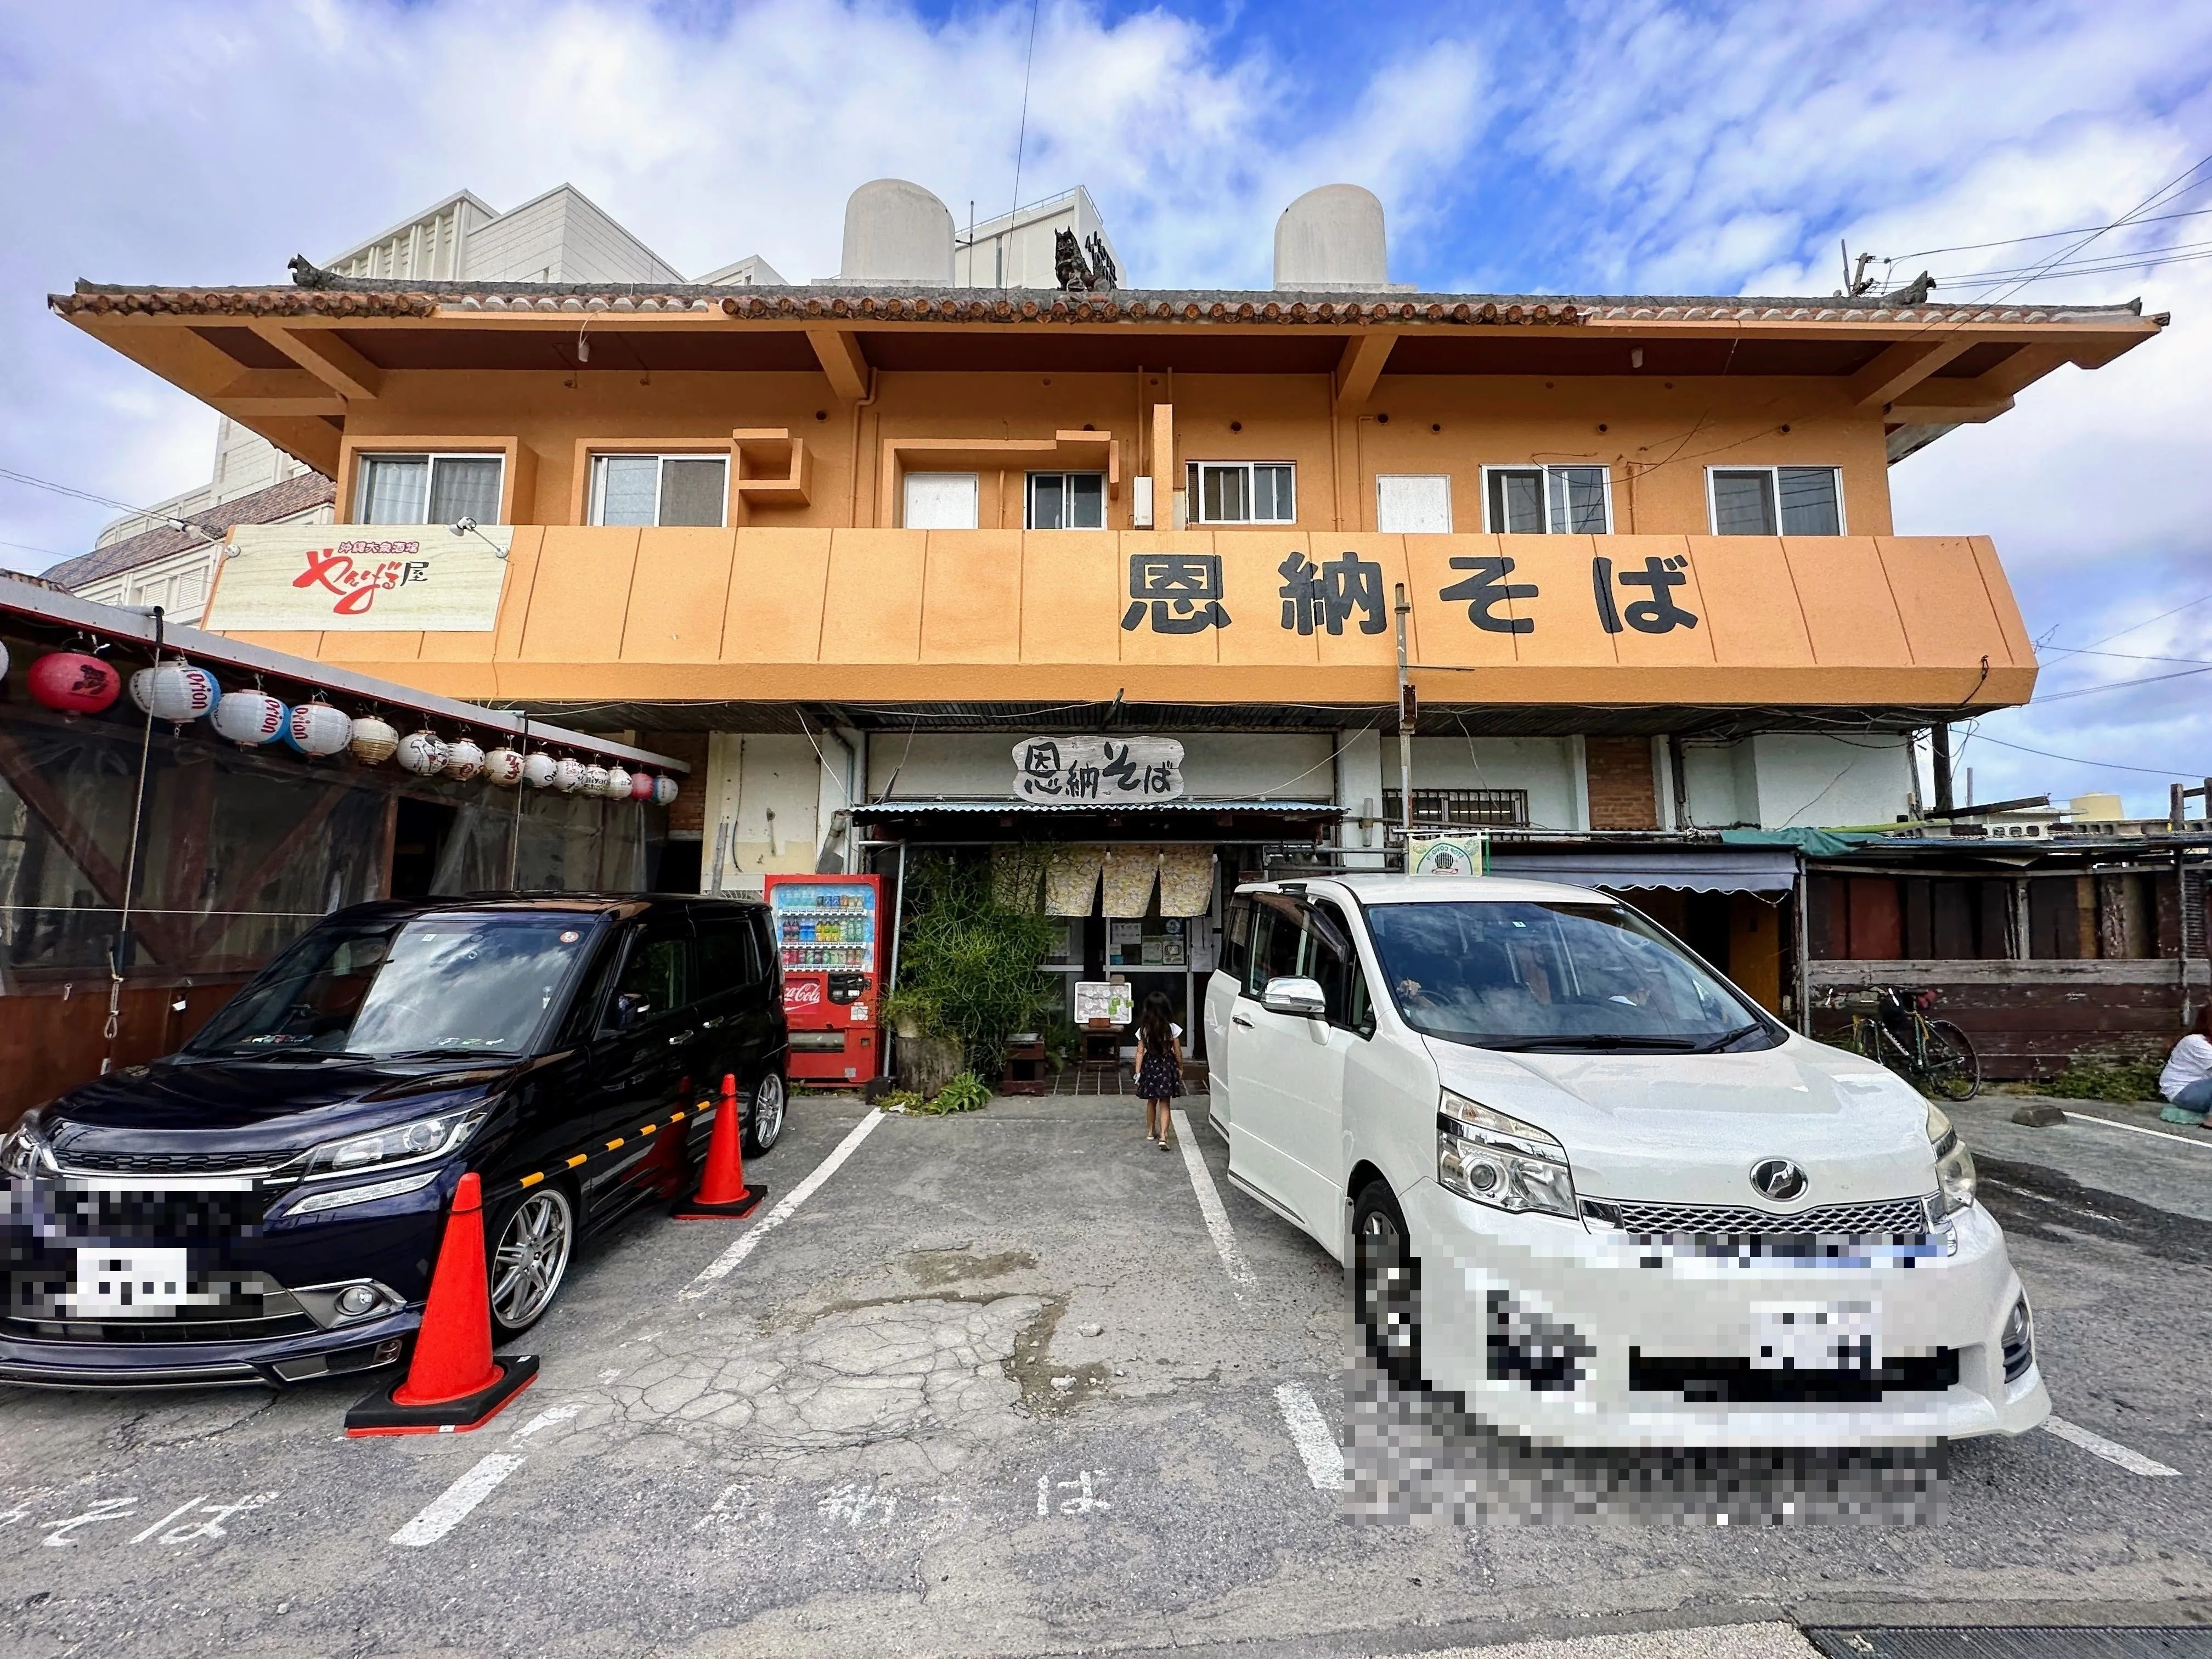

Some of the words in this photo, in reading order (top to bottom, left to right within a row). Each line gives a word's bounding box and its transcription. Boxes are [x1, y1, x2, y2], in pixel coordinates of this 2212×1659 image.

[337, 540, 420, 554] 沖縄大衆酒場
[292, 548, 430, 615] やんばる屋
[1120, 550, 1699, 636] 恩納そば
[1024, 741, 1173, 799] 恩納そば
